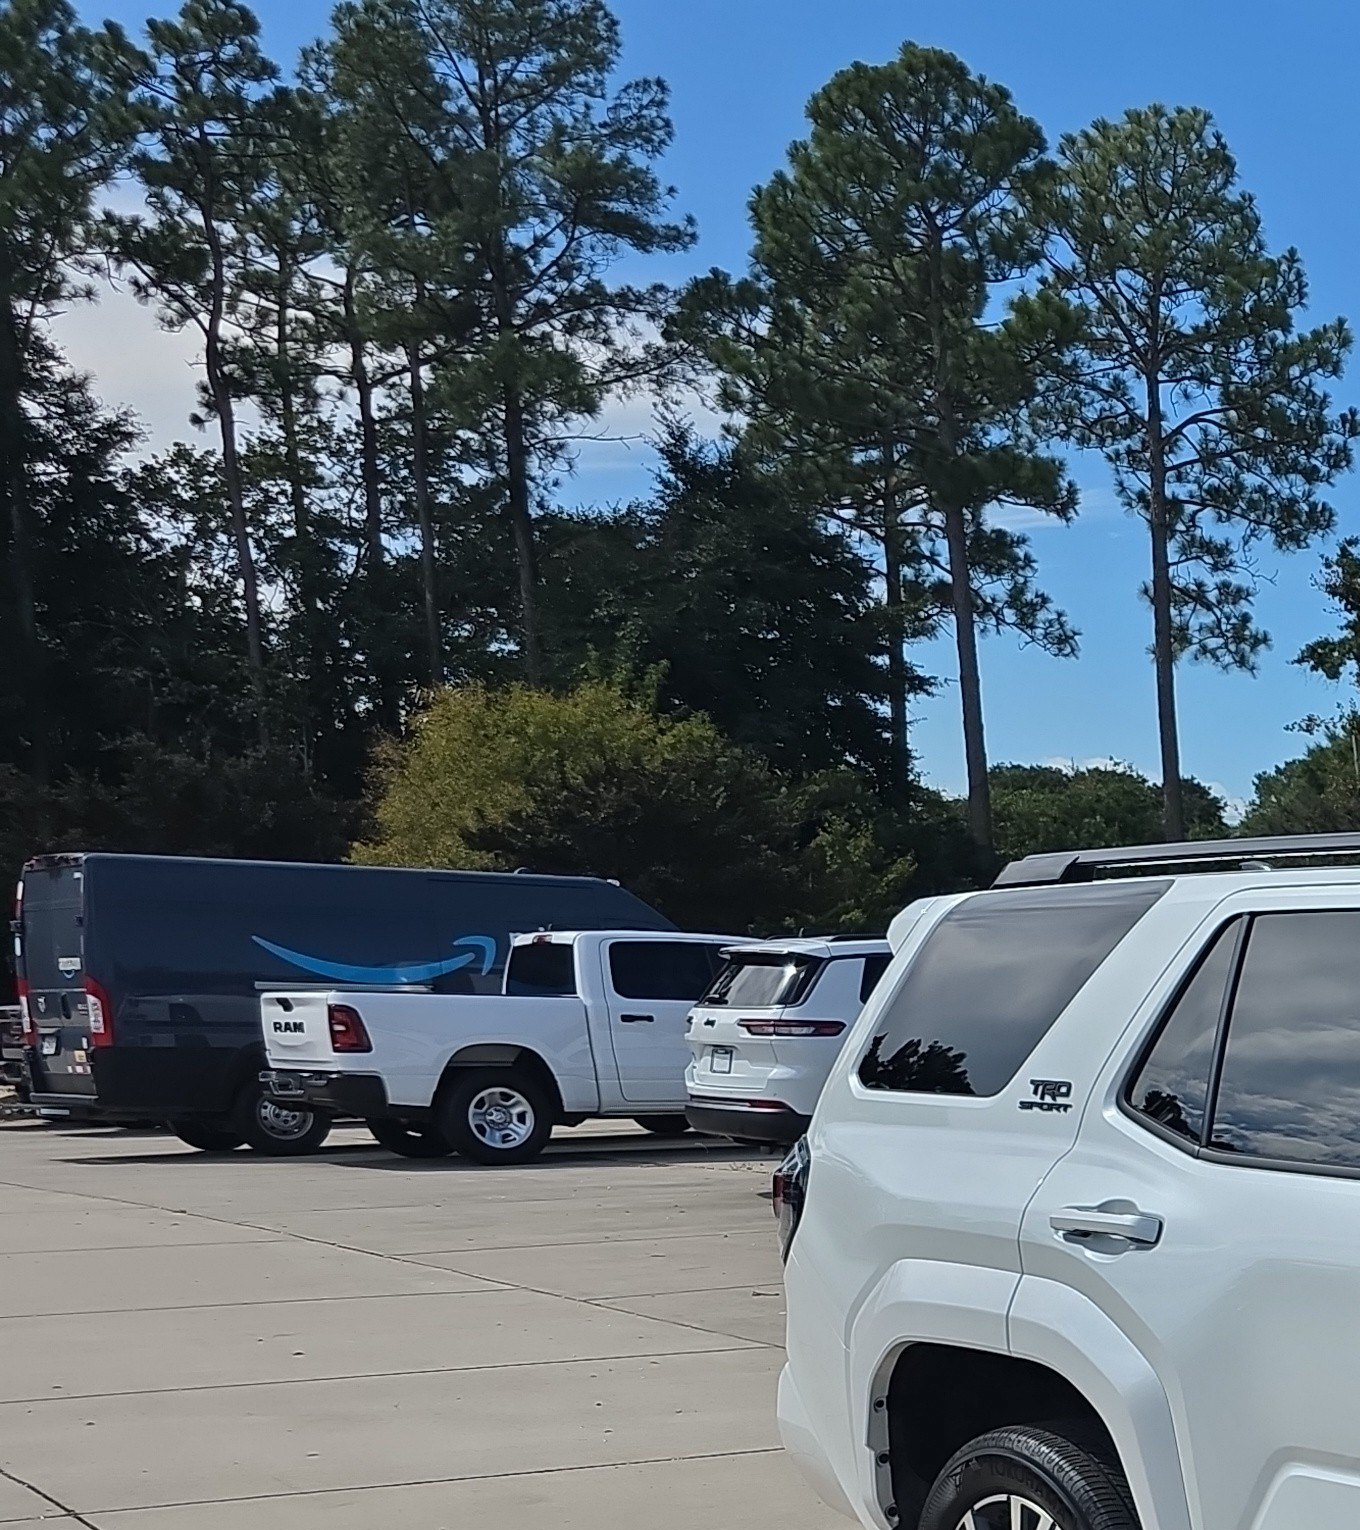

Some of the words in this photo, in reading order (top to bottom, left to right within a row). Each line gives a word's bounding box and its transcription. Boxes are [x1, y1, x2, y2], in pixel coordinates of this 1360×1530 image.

[272, 1021, 305, 1033] RAM
[1029, 1079, 1072, 1102] TRD
[1018, 1101, 1073, 1113] SPORT
